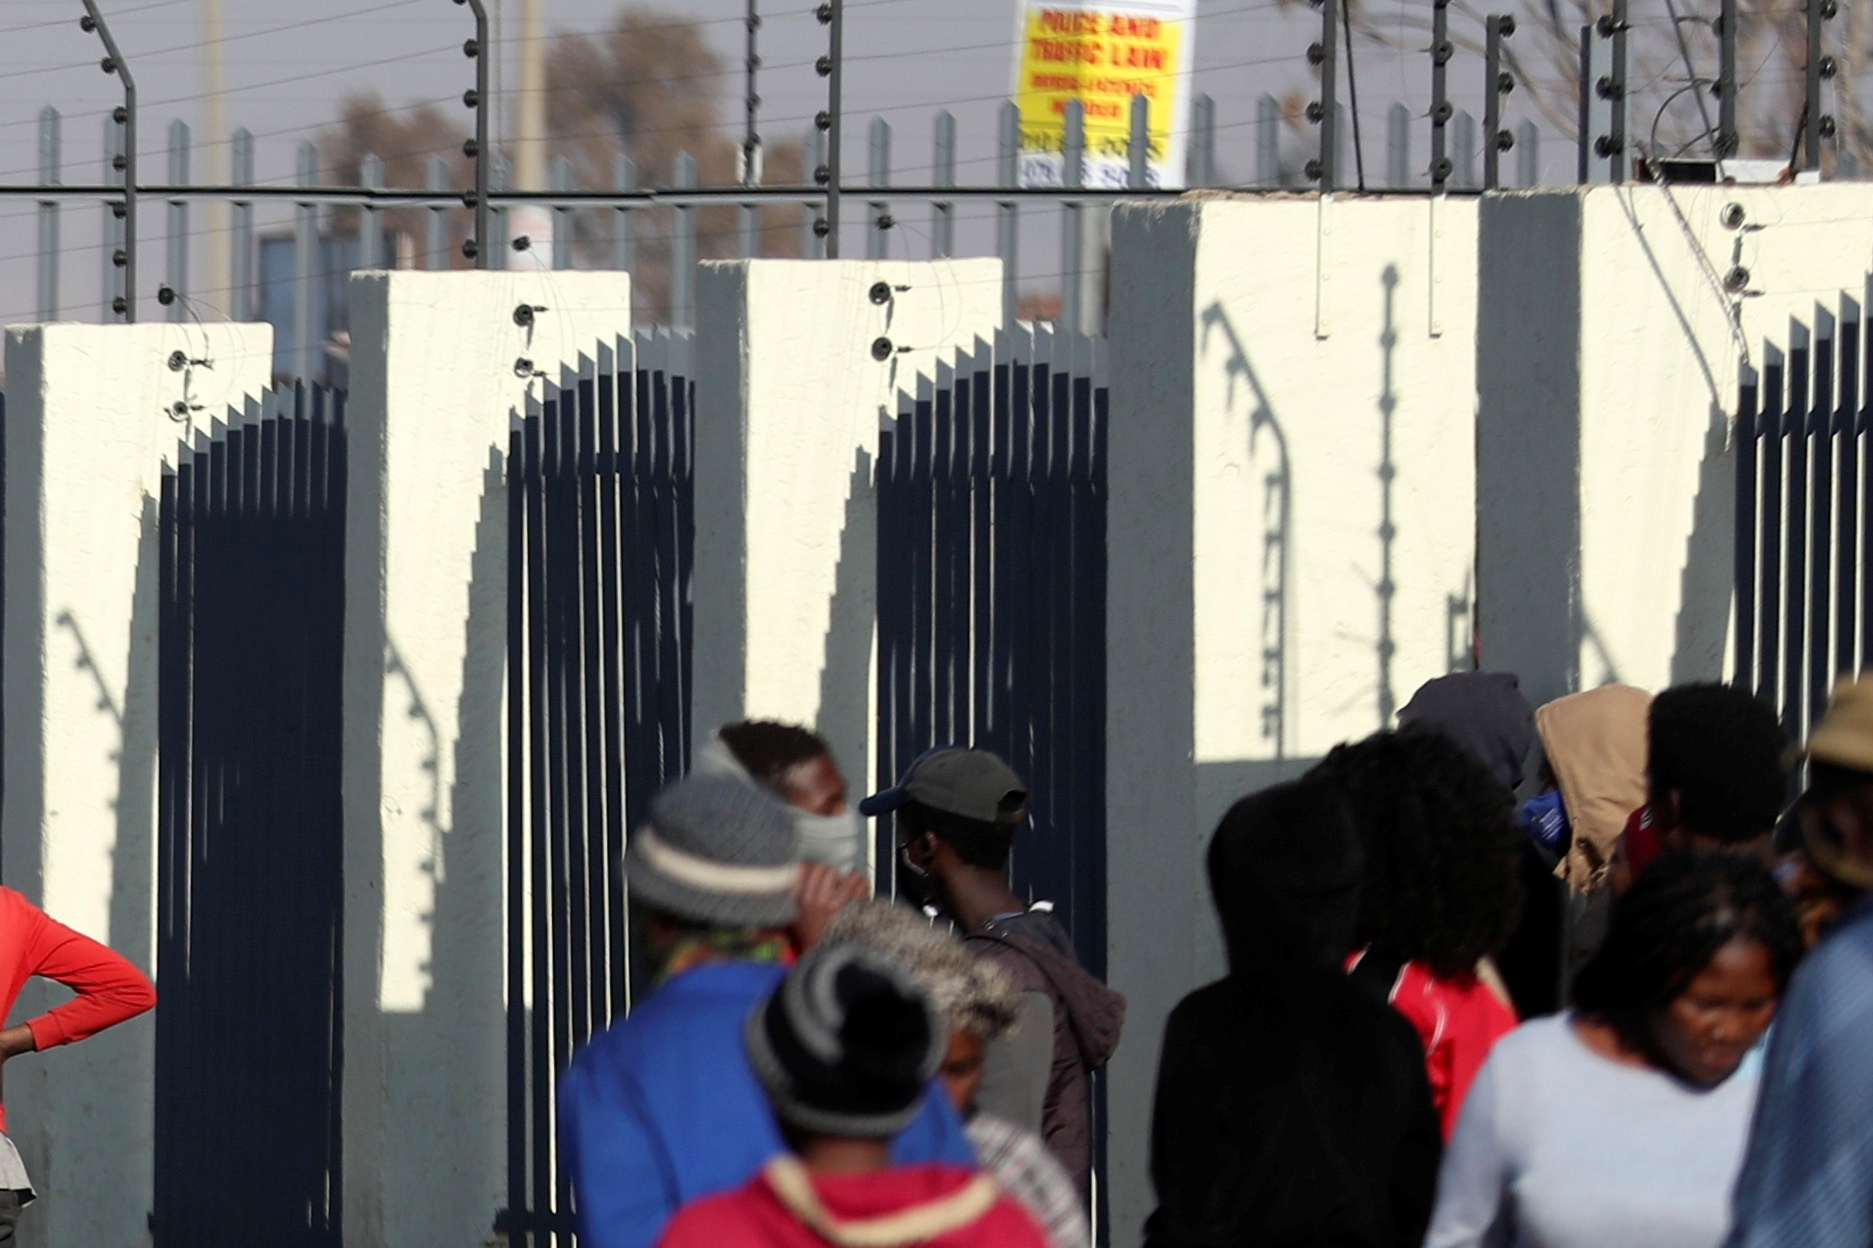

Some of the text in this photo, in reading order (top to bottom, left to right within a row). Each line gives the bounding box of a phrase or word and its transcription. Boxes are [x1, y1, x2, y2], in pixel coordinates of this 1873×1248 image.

[1039, 9, 1160, 38] POLICE AND
[1031, 37, 1101, 64] TRAFFIC
